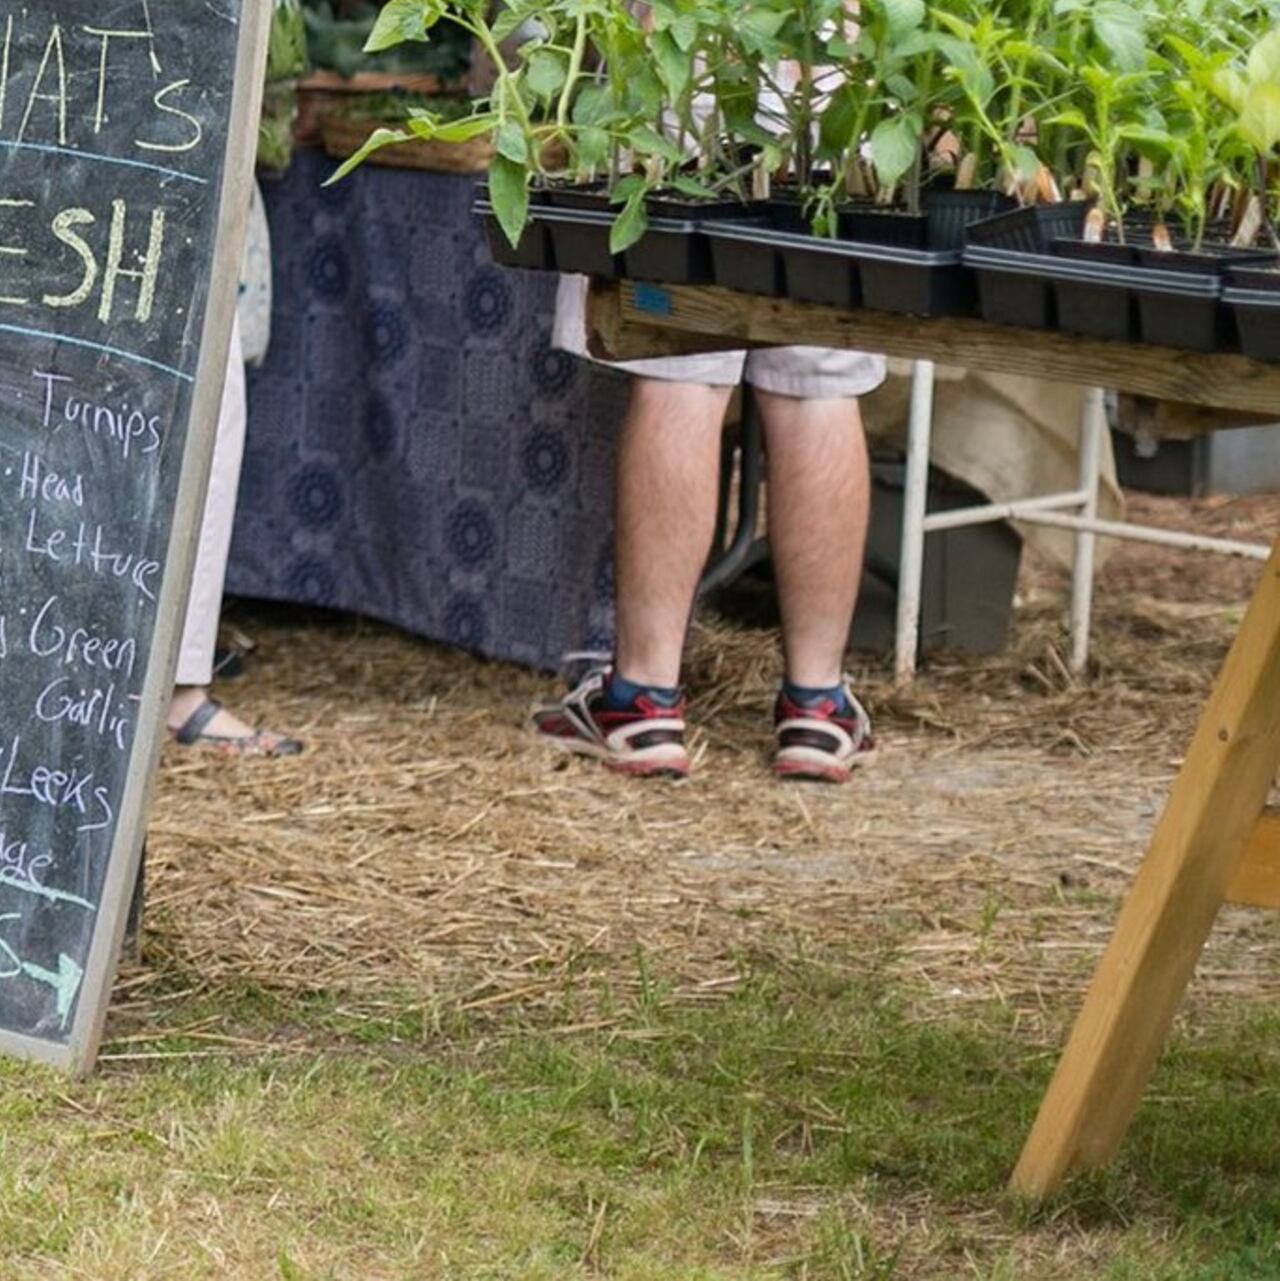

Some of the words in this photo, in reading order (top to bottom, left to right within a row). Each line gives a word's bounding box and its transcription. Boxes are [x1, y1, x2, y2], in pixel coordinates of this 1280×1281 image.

[34, 370, 161, 453] Turnips
[20, 454, 84, 506] Head
[27, 509, 160, 598] Lettuce
[30, 597, 136, 678] Green
[36, 677, 128, 750] Garlic
[0, 736, 112, 831] Leeks
